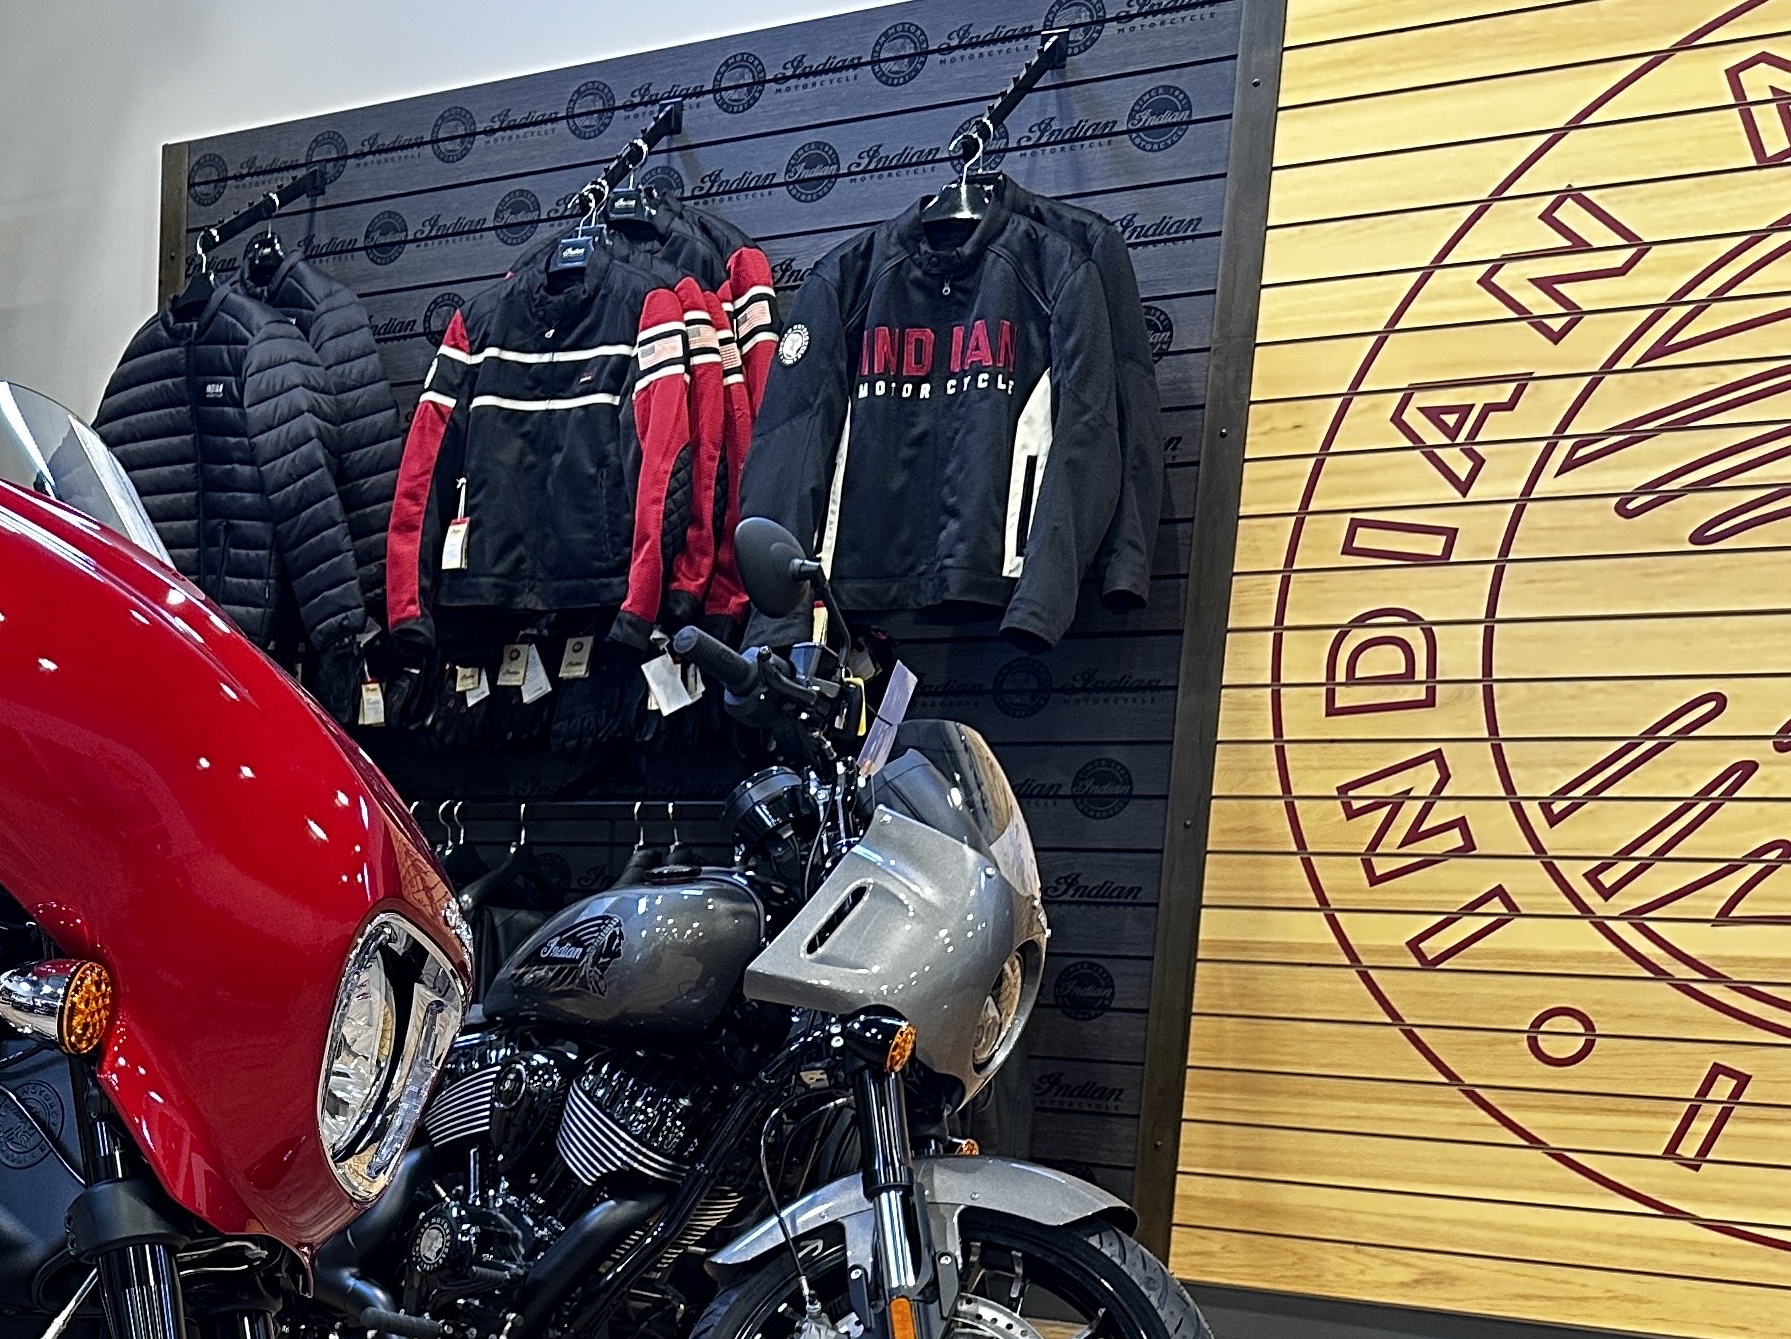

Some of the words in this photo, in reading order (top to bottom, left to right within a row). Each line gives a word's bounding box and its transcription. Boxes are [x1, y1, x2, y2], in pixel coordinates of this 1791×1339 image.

[937, 23, 1035, 56] Indian
[772, 54, 864, 86] Indian
[622, 81, 706, 113] Indian
[483, 108, 560, 138] Indian
[1019, 116, 1117, 148] Indian
[1127, 107, 1191, 129] Indian
[355, 132, 425, 161] Indian
[849, 142, 941, 172] Indian
[690, 167, 777, 197] Indian
[785, 161, 839, 182] Indian
[413, 213, 487, 239] Indian
[1112, 212, 1203, 241] Indian
[1061, 667, 1163, 695] Indian
[1044, 872, 1144, 900] Indian
[540, 936, 584, 960] Indian
[1033, 1071, 1126, 1101] Indian
